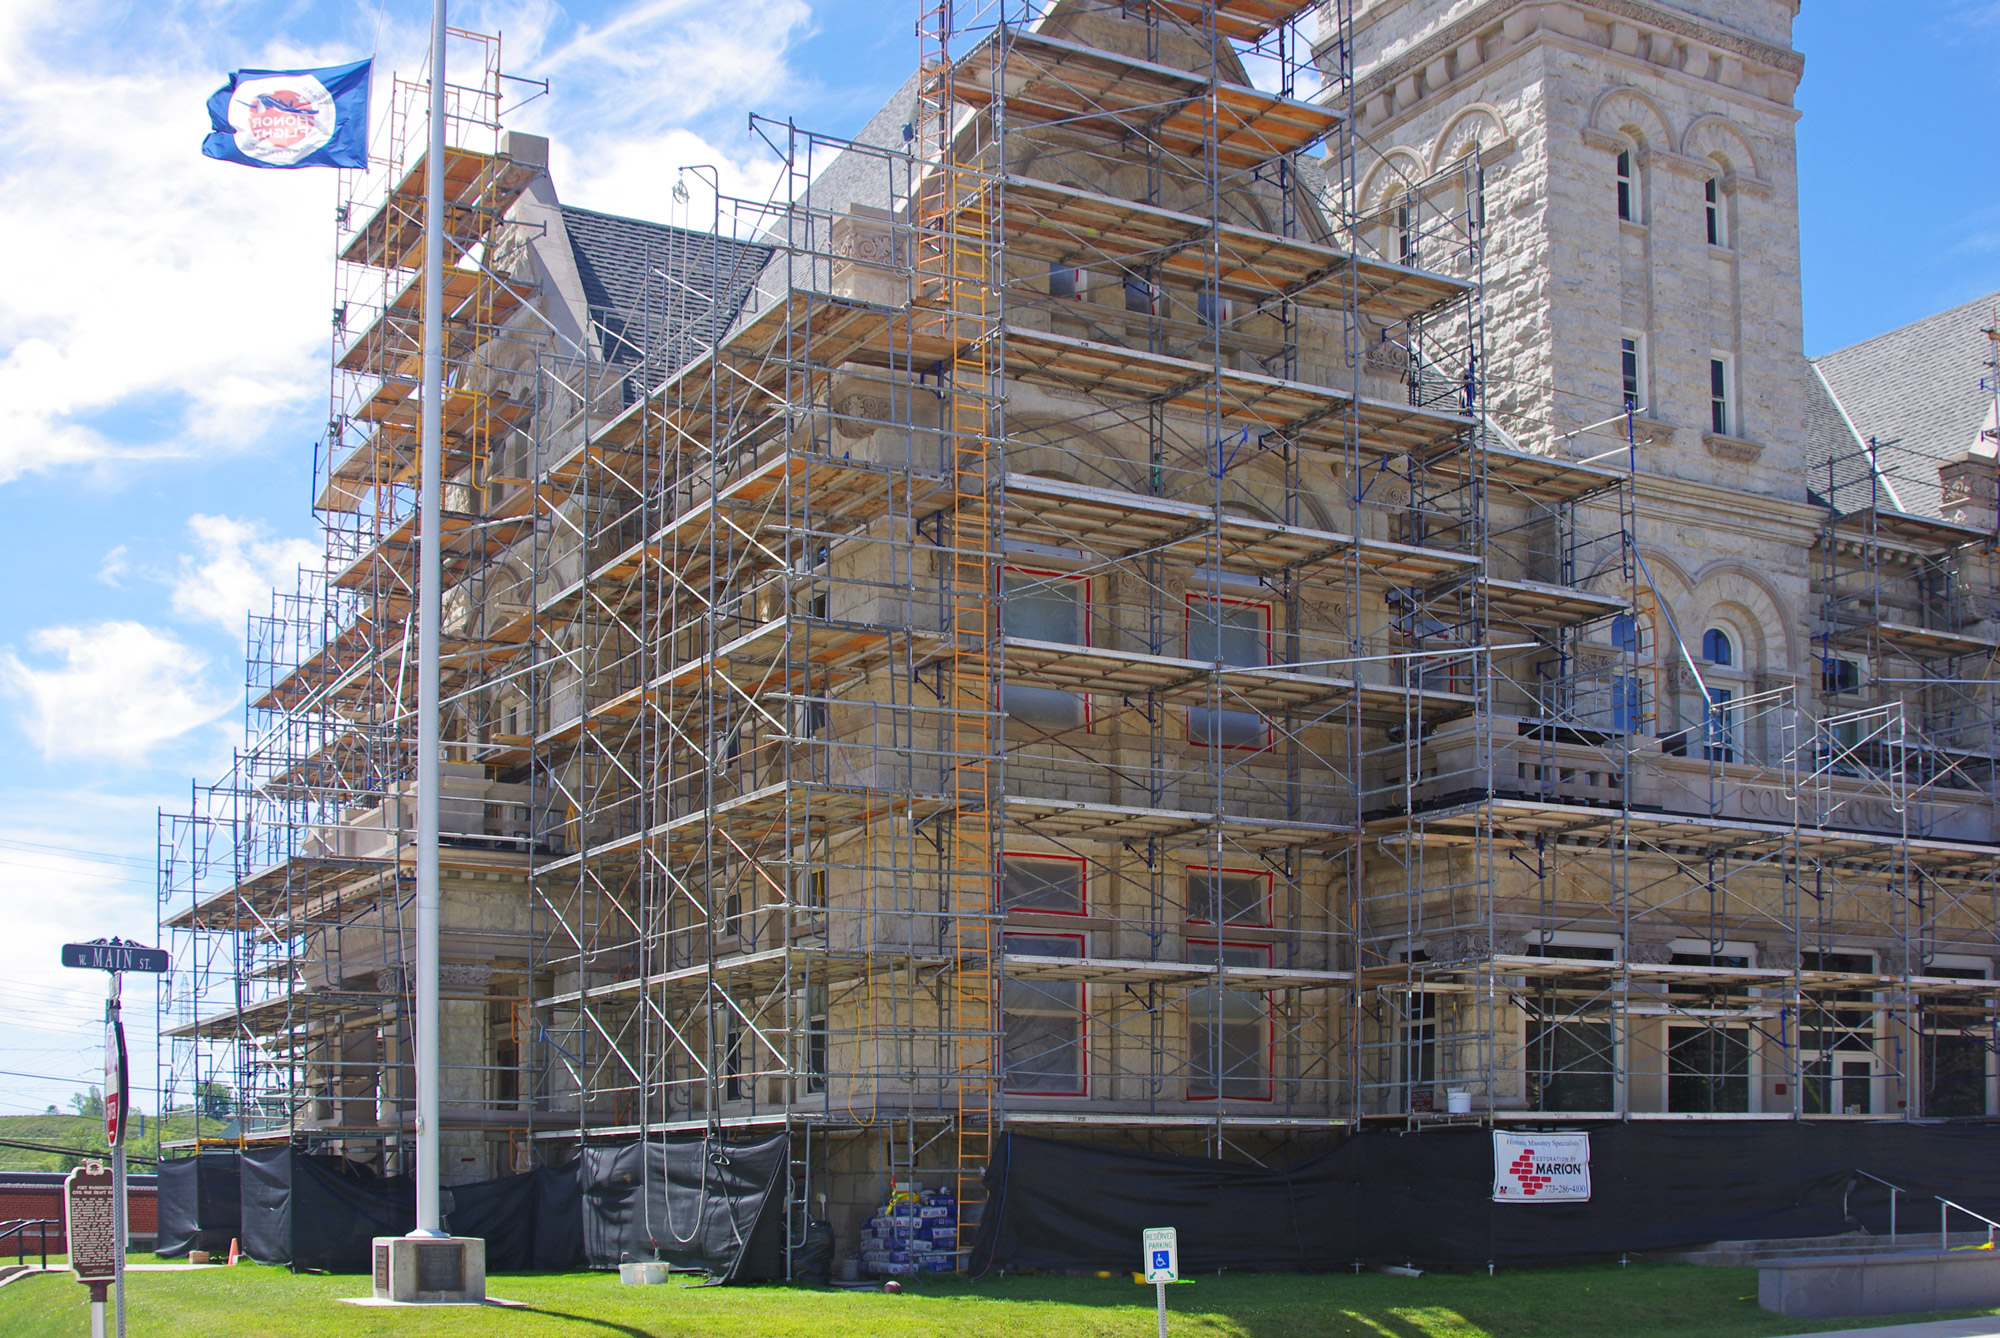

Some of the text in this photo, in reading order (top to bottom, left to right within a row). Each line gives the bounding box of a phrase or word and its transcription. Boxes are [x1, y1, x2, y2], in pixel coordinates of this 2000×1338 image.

[78, 947, 152, 970] W. MAIN ST.
[1528, 1140, 1551, 1149] Masonry
[1535, 1163, 1581, 1174] MARION
[1146, 1232, 1174, 1241] RESERVED
[1149, 1242, 1173, 1251] PARKING
